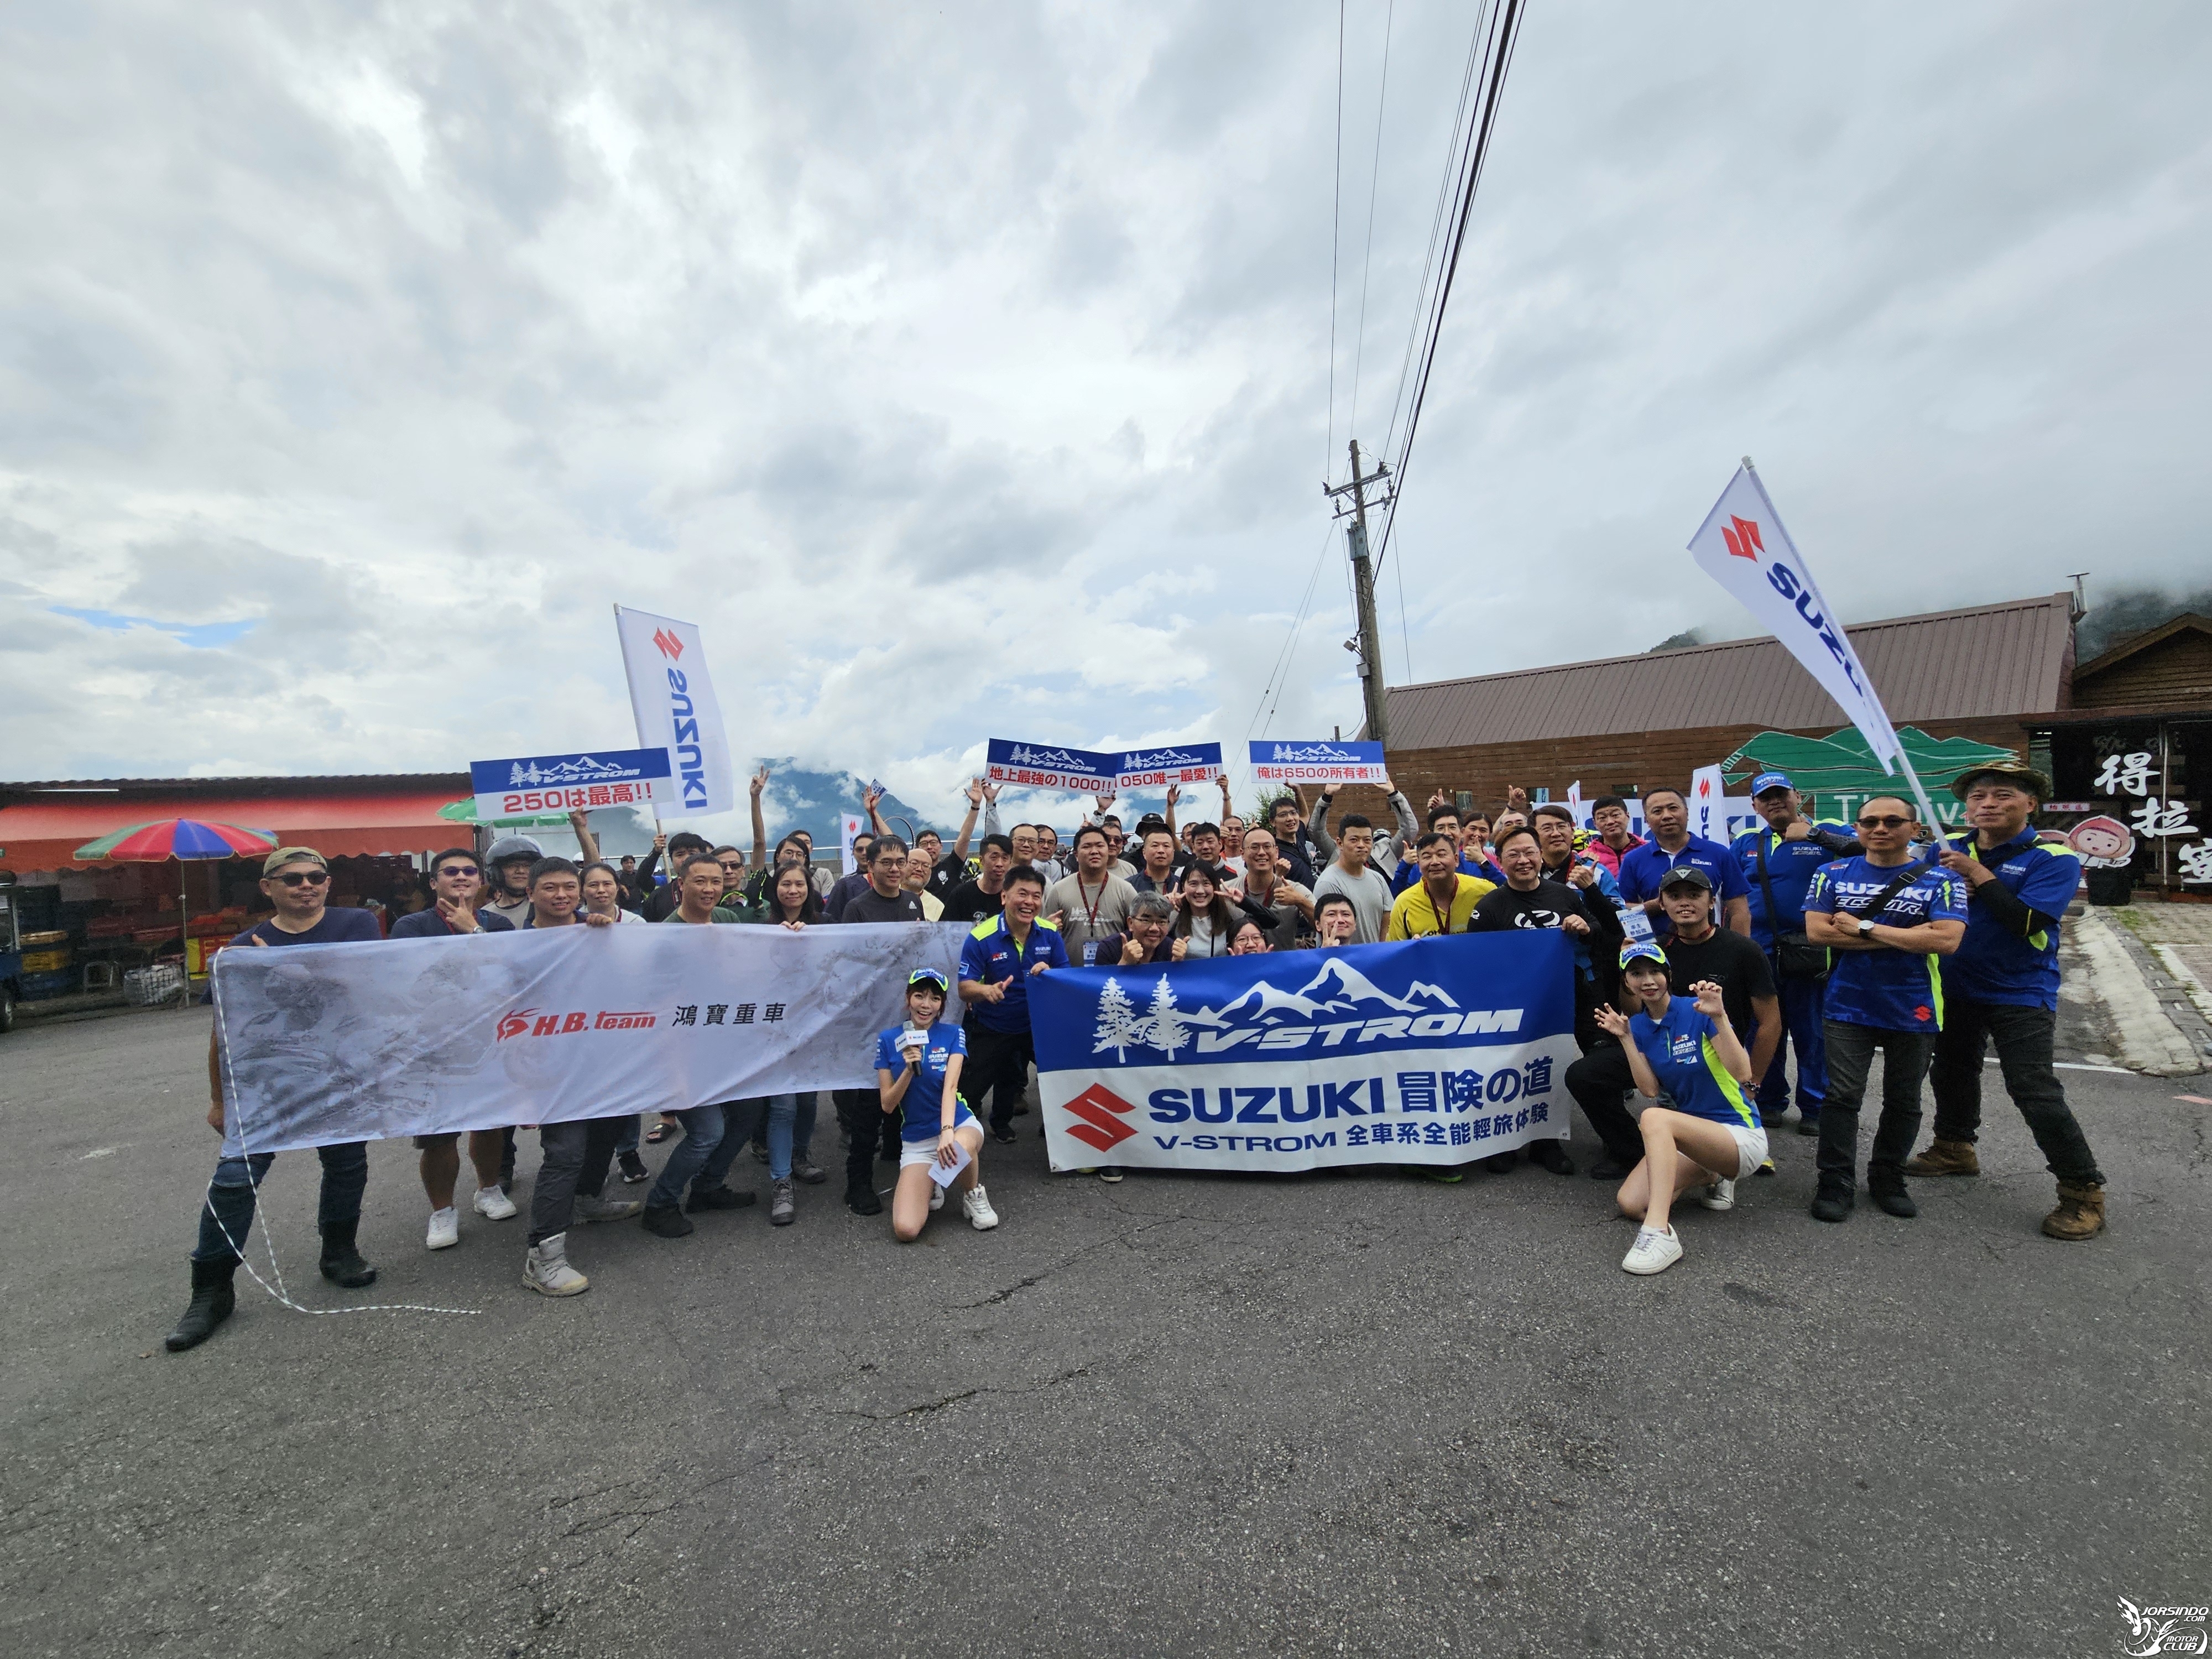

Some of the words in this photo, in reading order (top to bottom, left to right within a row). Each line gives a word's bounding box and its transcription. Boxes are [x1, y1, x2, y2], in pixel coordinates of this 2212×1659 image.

[1766, 562, 1875, 730] SUZU
[543, 768, 641, 784] V-STROM
[1031, 759, 1097, 773] V-STROM
[1142, 757, 1203, 769] V-STROM
[1256, 766, 1381, 779] 俺は650の所有者!!
[989, 765, 1112, 792] 地上最強の1000!!
[503, 782, 653, 813] 250は最高!!
[531, 1011, 589, 1037] H.B.
[594, 1010, 656, 1030] team
[672, 1001, 787, 1027] 鴻寶重車
[1196, 1008, 1525, 1054] V-STROM
[1672, 1040, 1697, 1051] SUZUKI
[1148, 1077, 1385, 1124] SUZUKI
[1396, 1055, 1553, 1113] 冒険の道
[1153, 1130, 1337, 1153] V-STROM
[1346, 1104, 1549, 1149] 全車系全能輕旅体験
